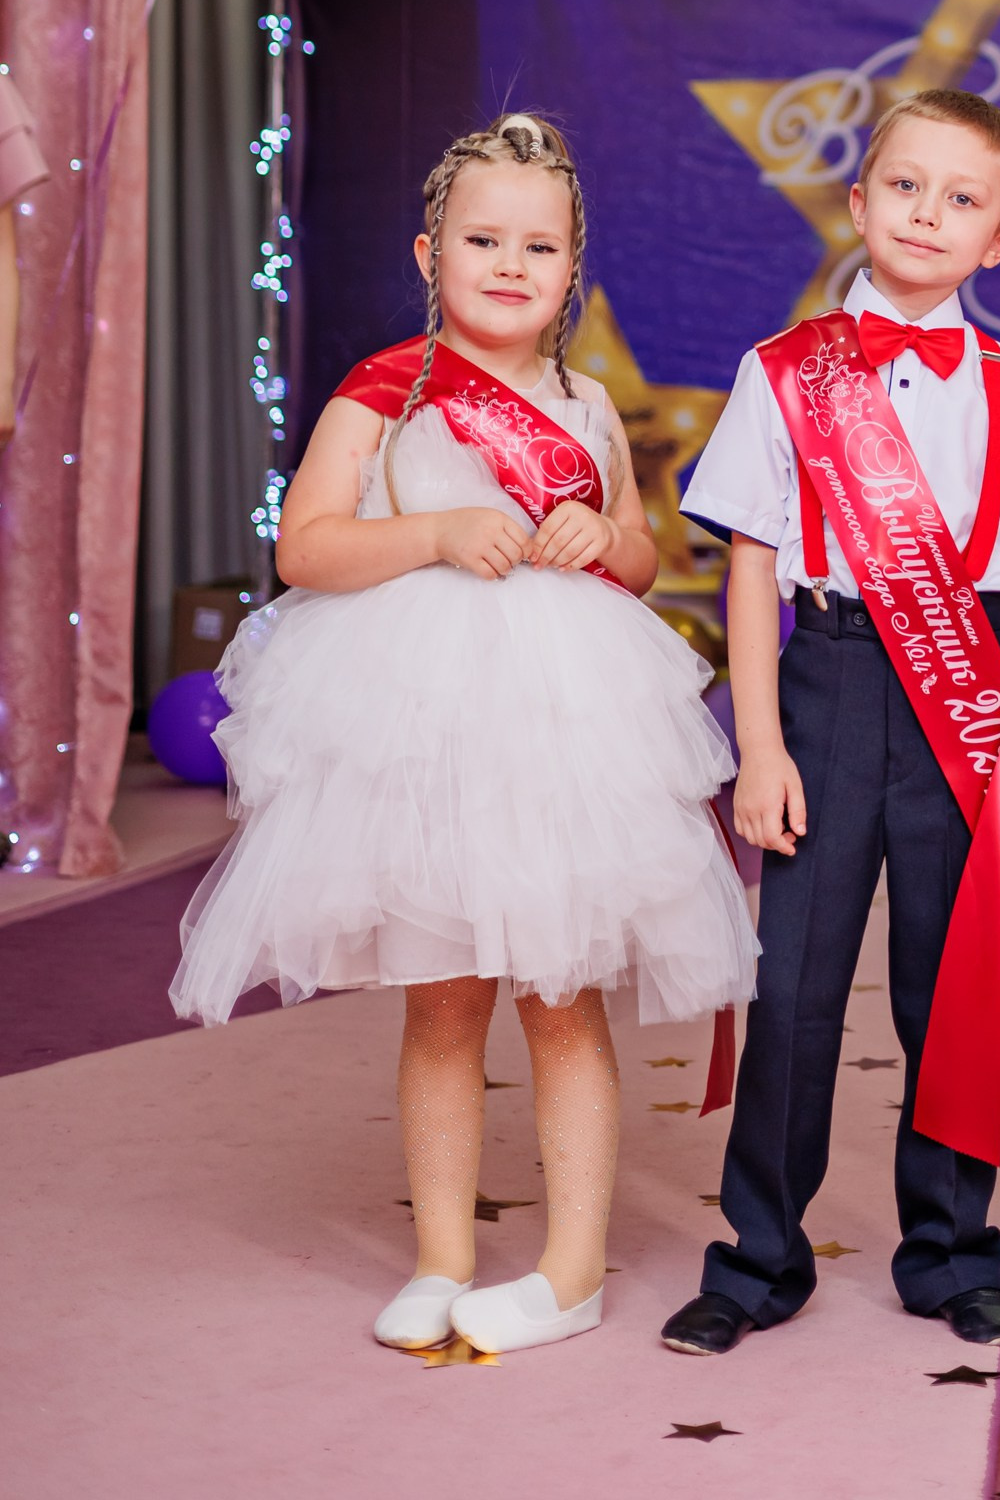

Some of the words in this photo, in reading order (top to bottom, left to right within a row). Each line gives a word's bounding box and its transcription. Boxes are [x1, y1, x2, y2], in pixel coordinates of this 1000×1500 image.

[808, 455, 870, 553] детского
[862, 556, 896, 609] сада
[844, 420, 977, 687] Выпускник
[951, 586, 980, 647] Роман
